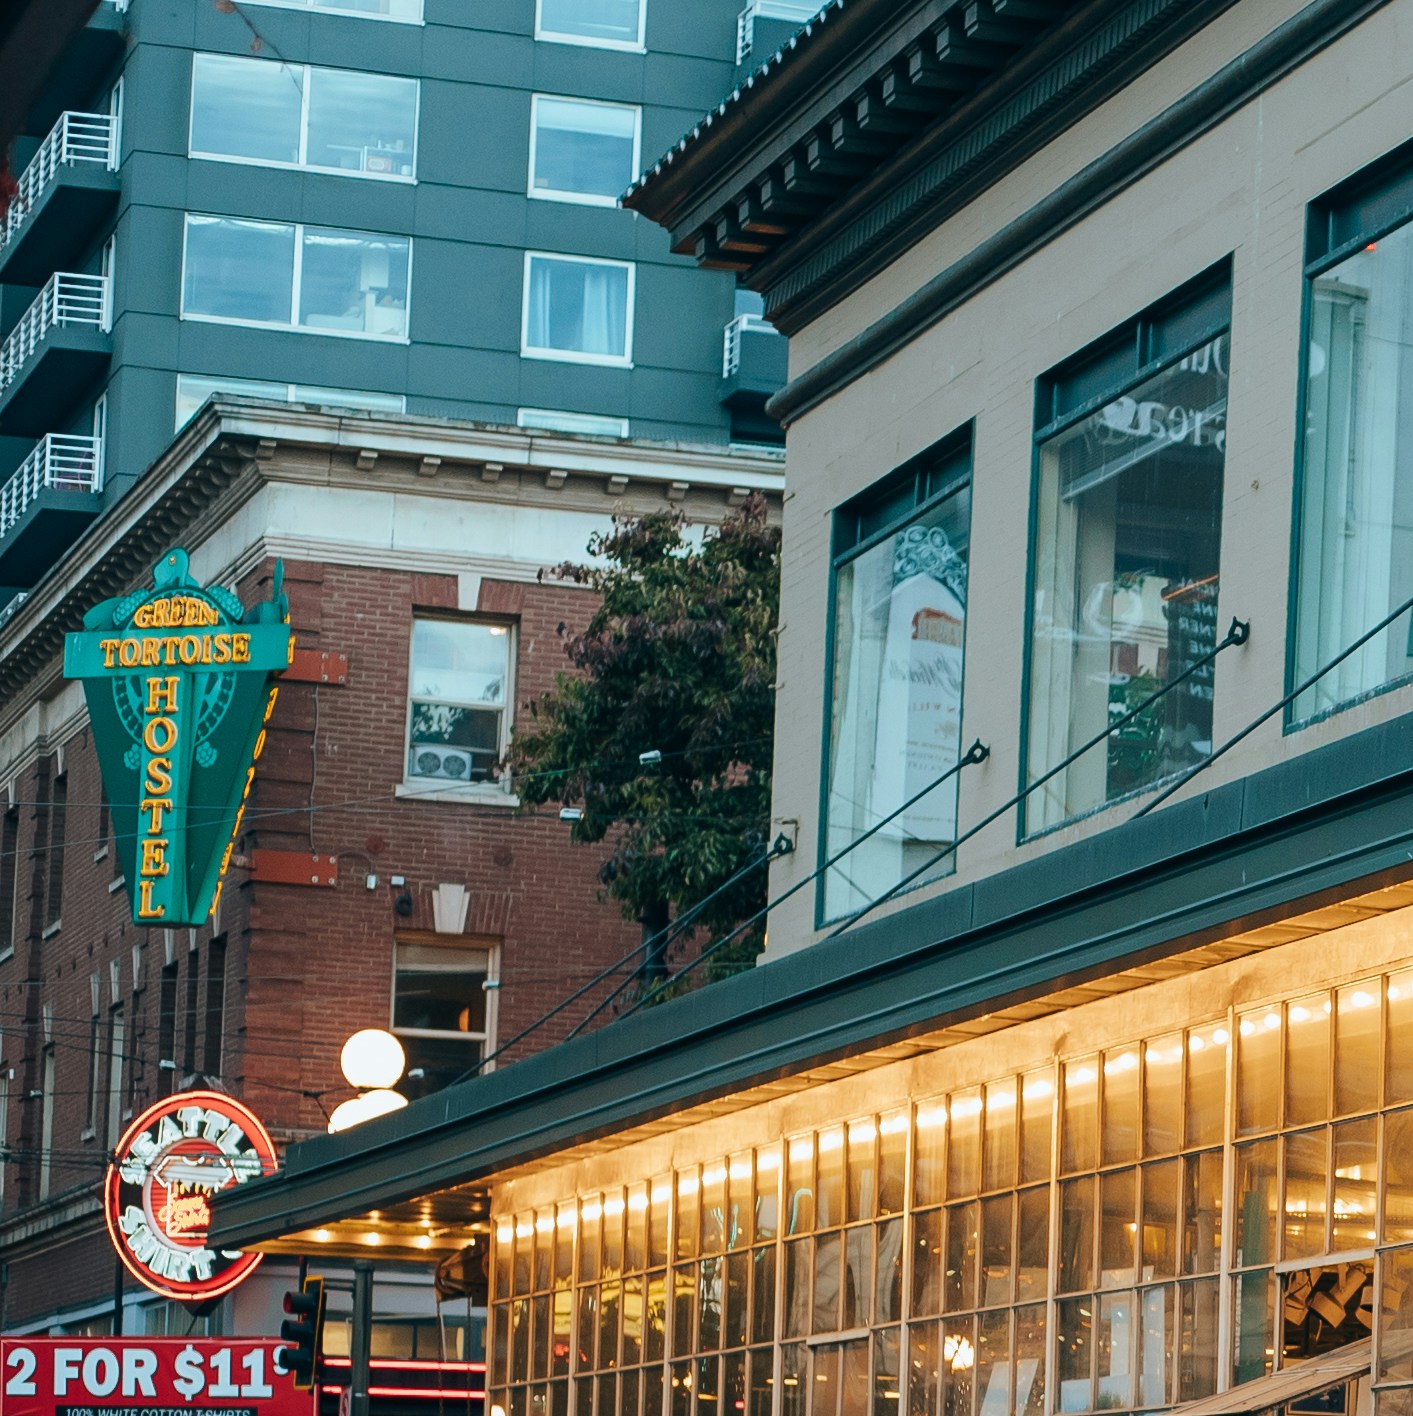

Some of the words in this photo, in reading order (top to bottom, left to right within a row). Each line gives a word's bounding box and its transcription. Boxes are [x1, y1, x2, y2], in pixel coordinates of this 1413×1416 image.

[133, 597, 219, 628] GREEN
[99, 633, 251, 668] TORTOISE
[138, 676, 179, 918] HOSTEL
[5, 1348, 37, 1395] 2
[53, 1348, 158, 1396] FOR
